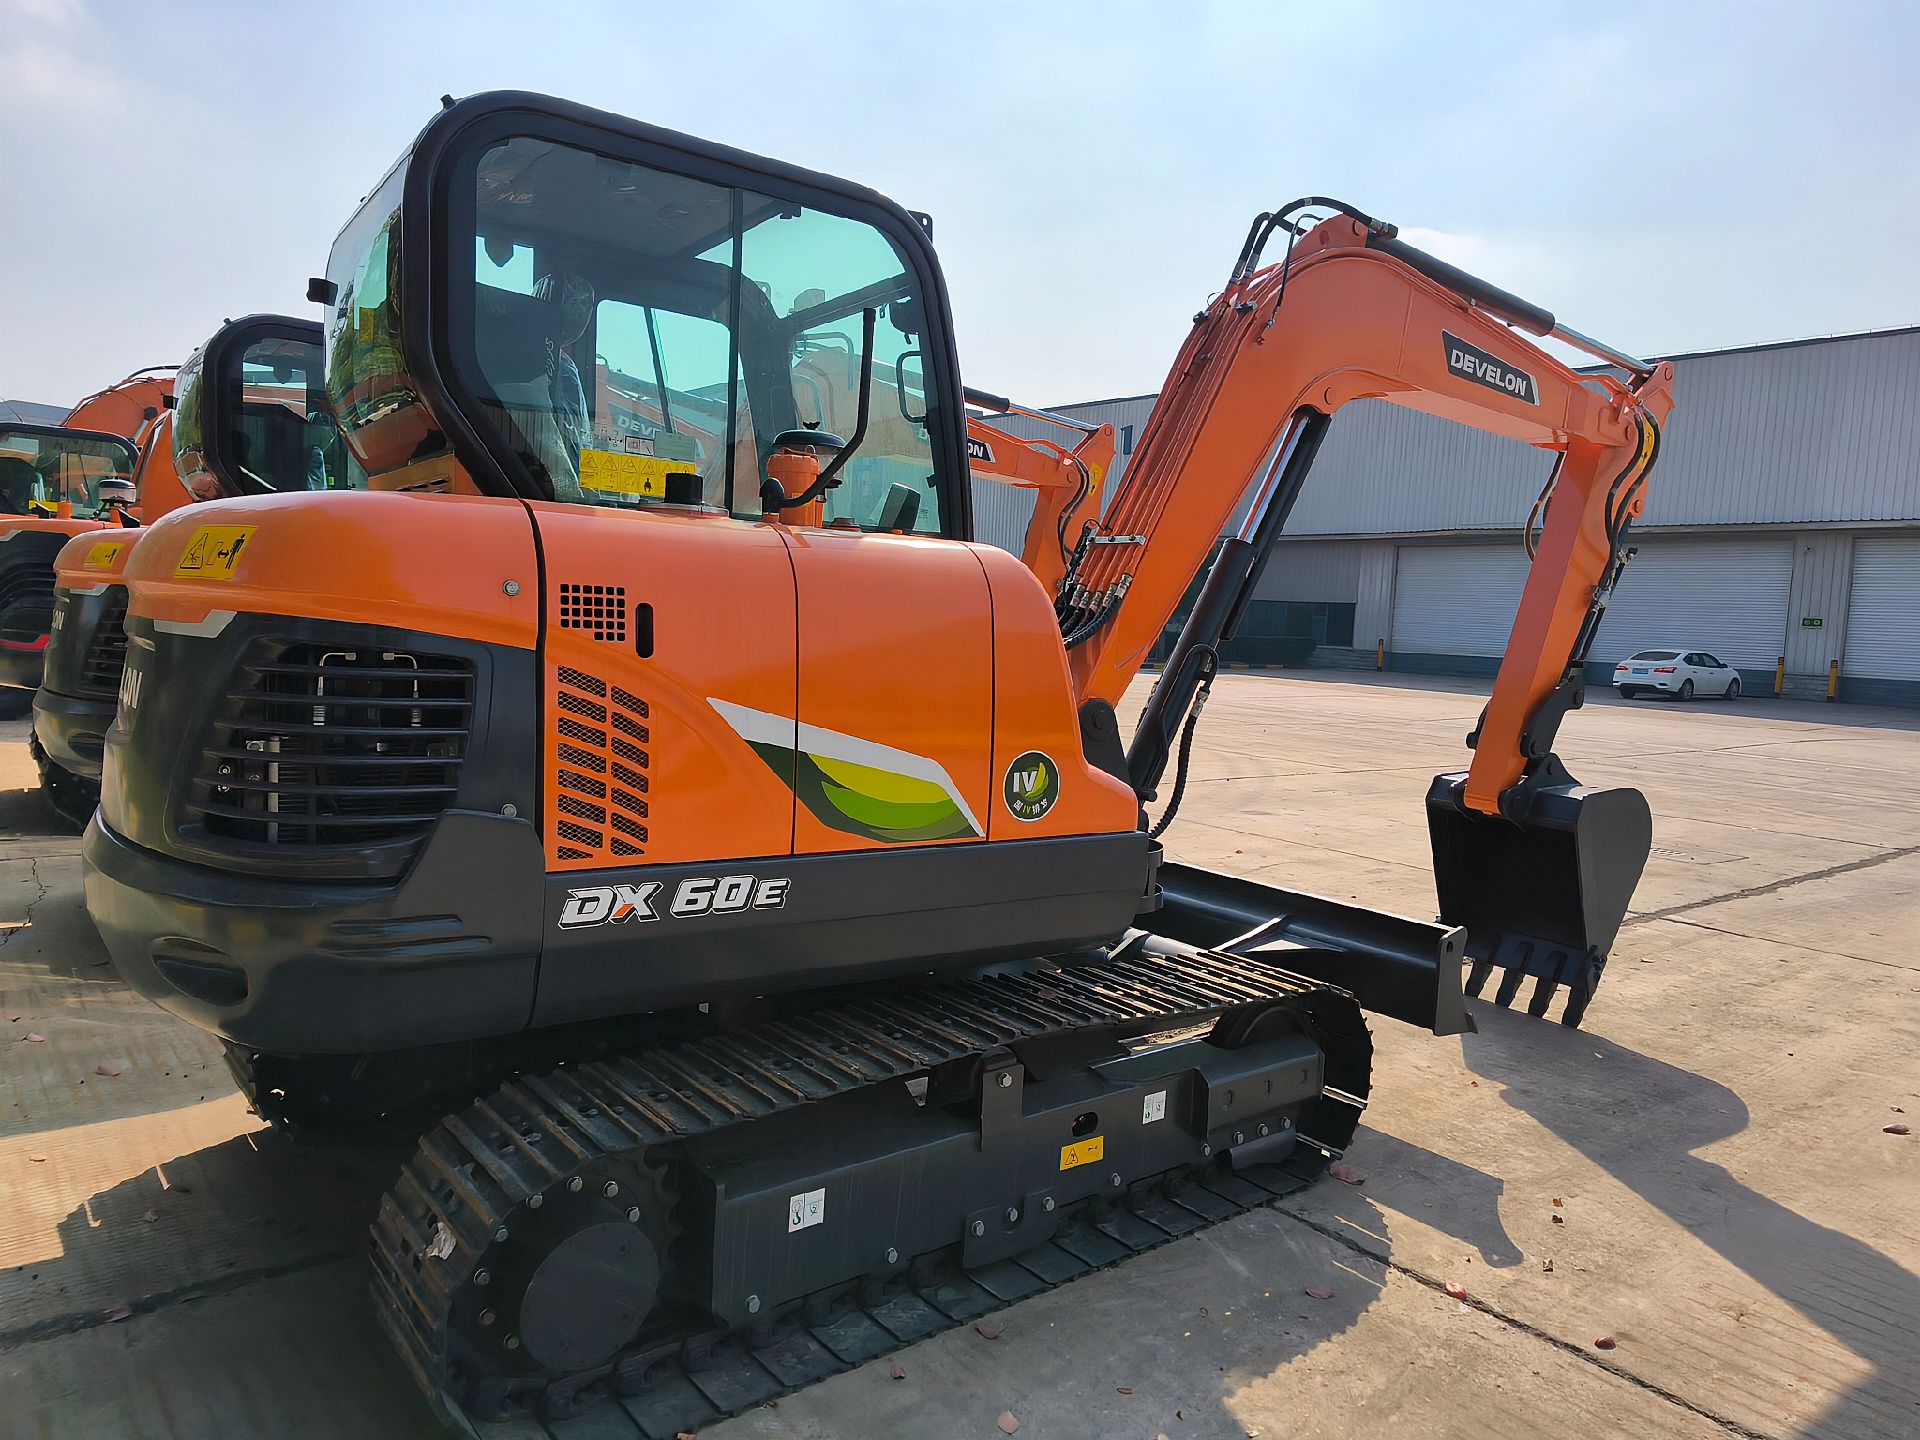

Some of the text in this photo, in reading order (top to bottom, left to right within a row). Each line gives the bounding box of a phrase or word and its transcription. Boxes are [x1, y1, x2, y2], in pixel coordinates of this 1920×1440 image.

[1450, 348, 1528, 397] DEVELON
[1013, 770, 1038, 793] IV
[557, 882, 664, 930] DX
